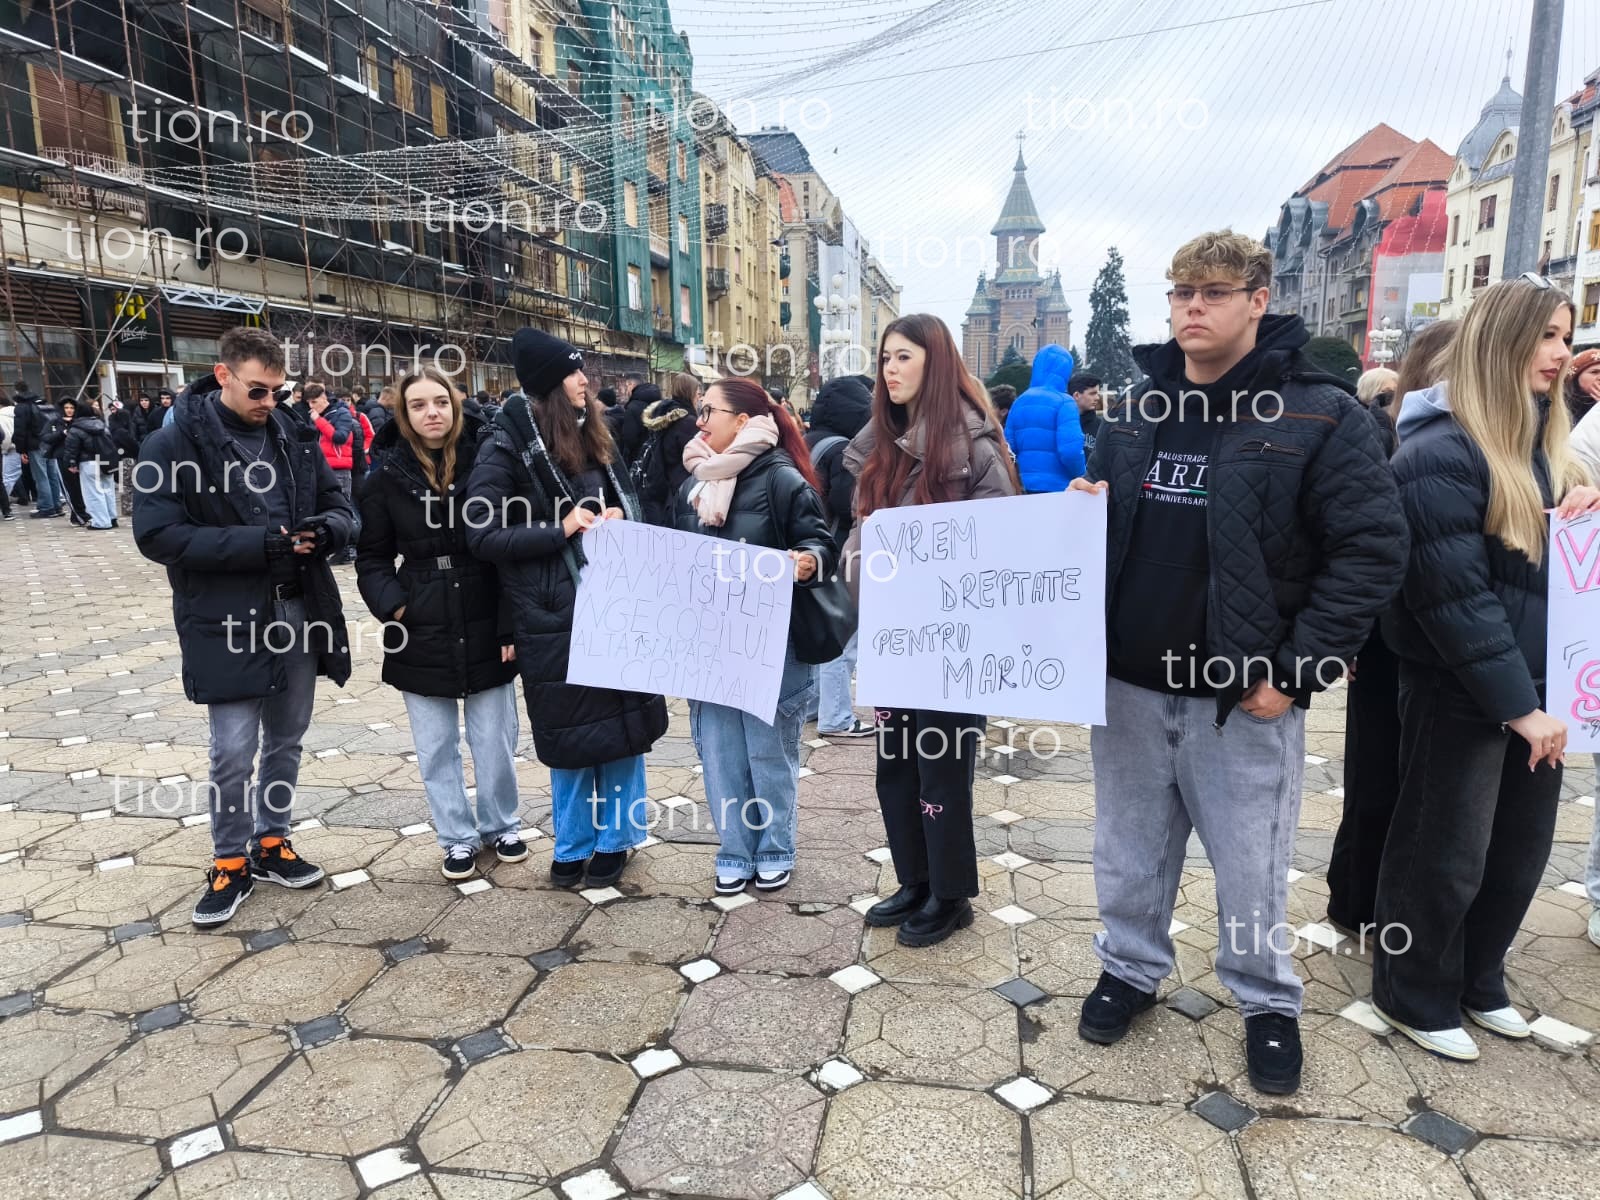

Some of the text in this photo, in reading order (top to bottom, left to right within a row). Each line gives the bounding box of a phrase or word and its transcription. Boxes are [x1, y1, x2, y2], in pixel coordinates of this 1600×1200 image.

[1157, 451, 1209, 463] BALUSTRADE
[1155, 493, 1208, 507] ANNIVERSARY
[875, 515, 978, 569] VREM
[1555, 526, 1600, 593] V
[938, 567, 1082, 612] DREPTATE
[872, 621, 971, 656] PENTRU
